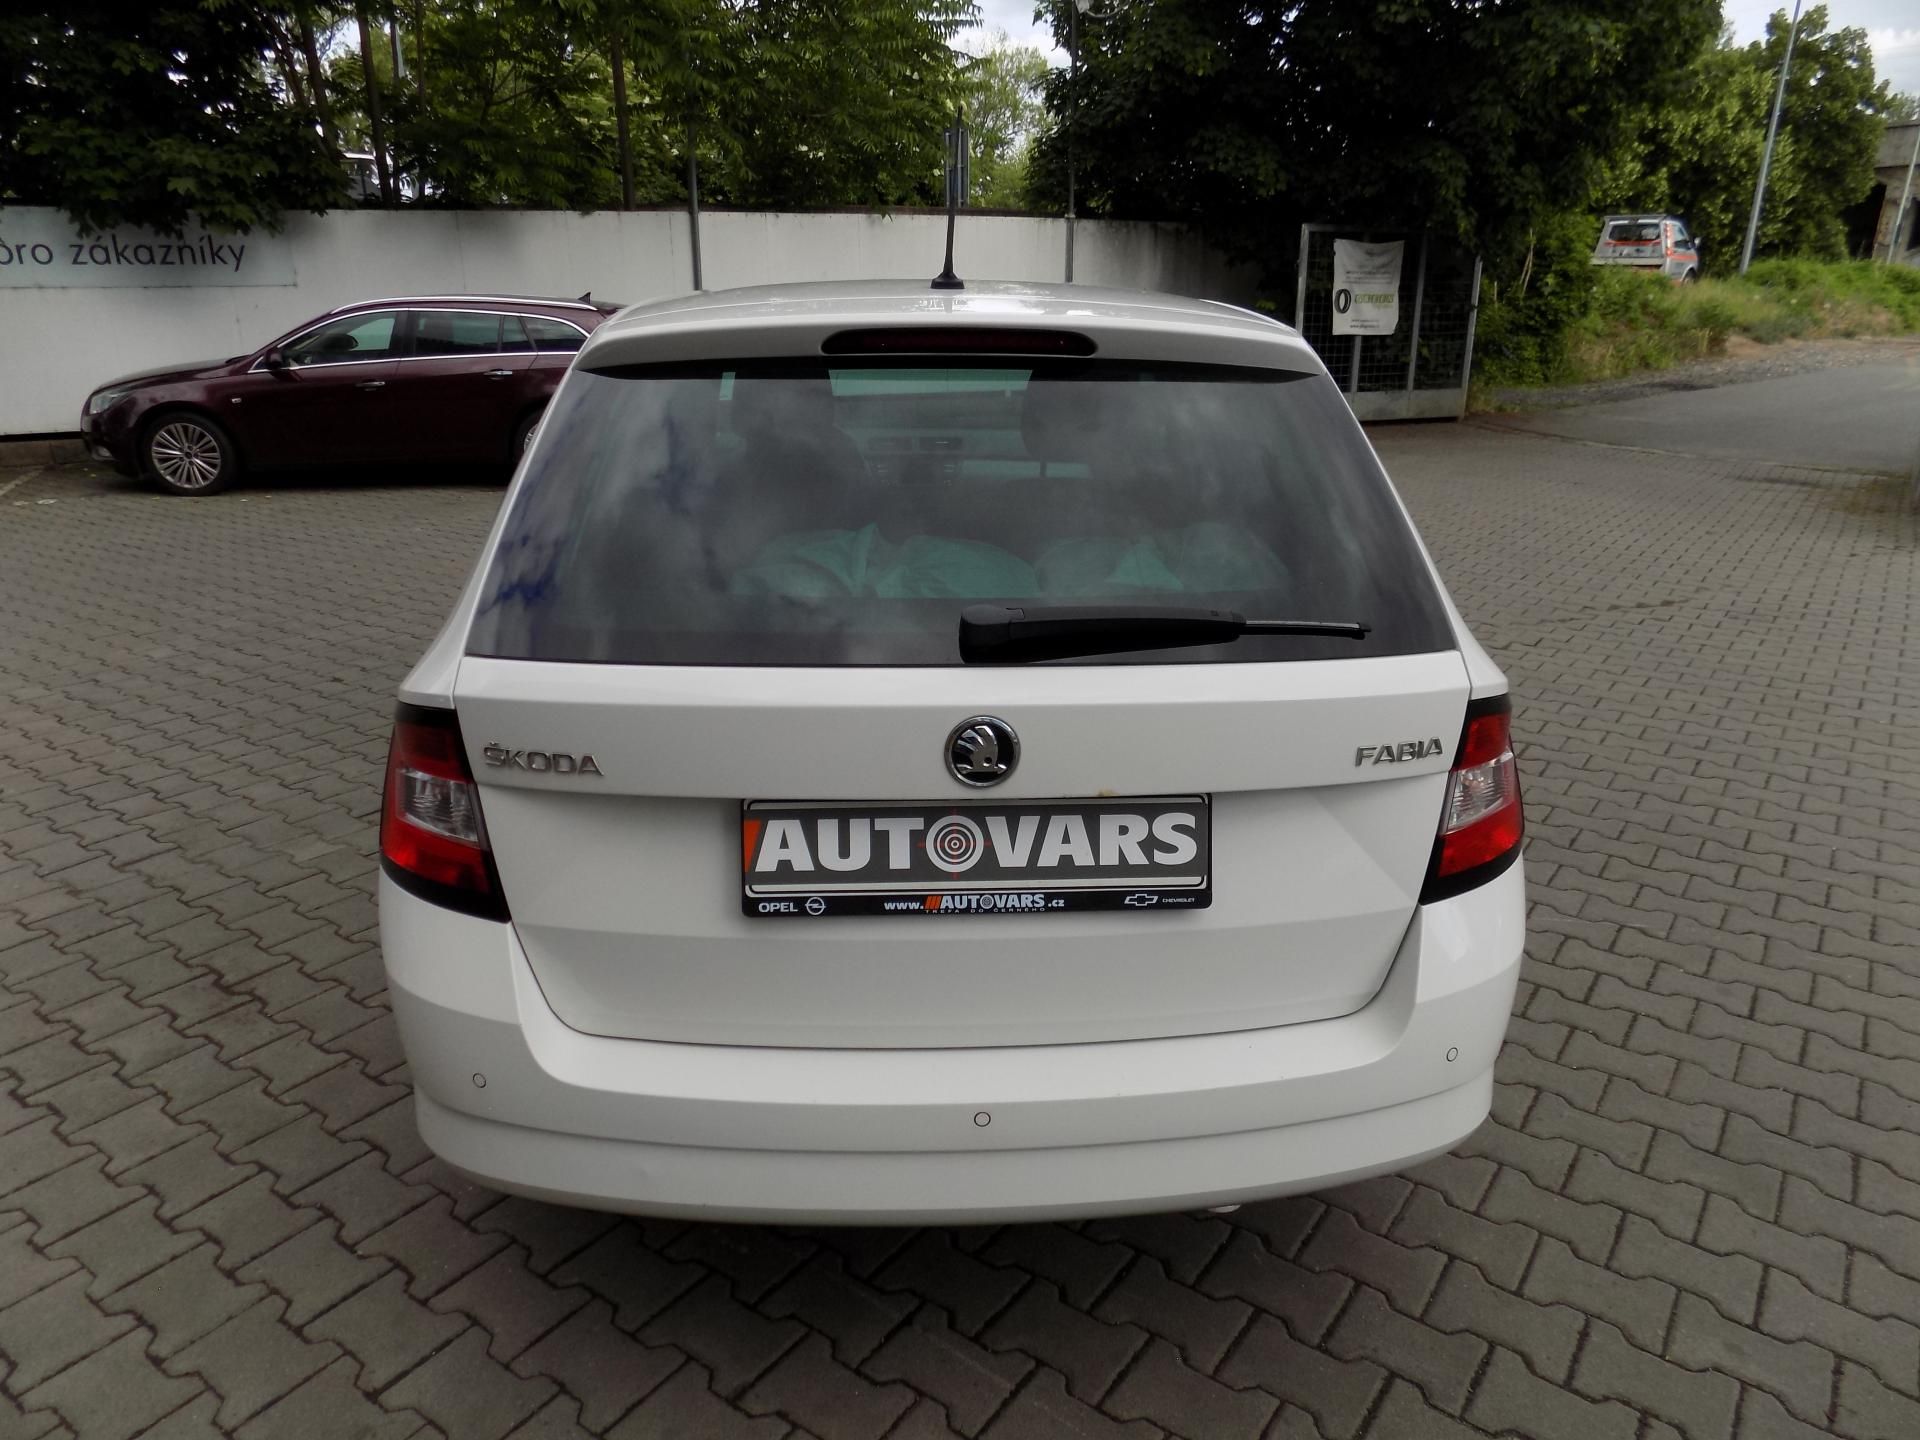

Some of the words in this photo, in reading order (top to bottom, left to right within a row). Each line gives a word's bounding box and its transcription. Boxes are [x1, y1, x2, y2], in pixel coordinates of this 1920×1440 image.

[68, 234, 246, 272] zákazníky
[483, 741, 605, 776] ŠKODA
[1355, 737, 1443, 767] FABIA
[755, 812, 1198, 873] AUTOVARS
[758, 902, 799, 913] OPEL
